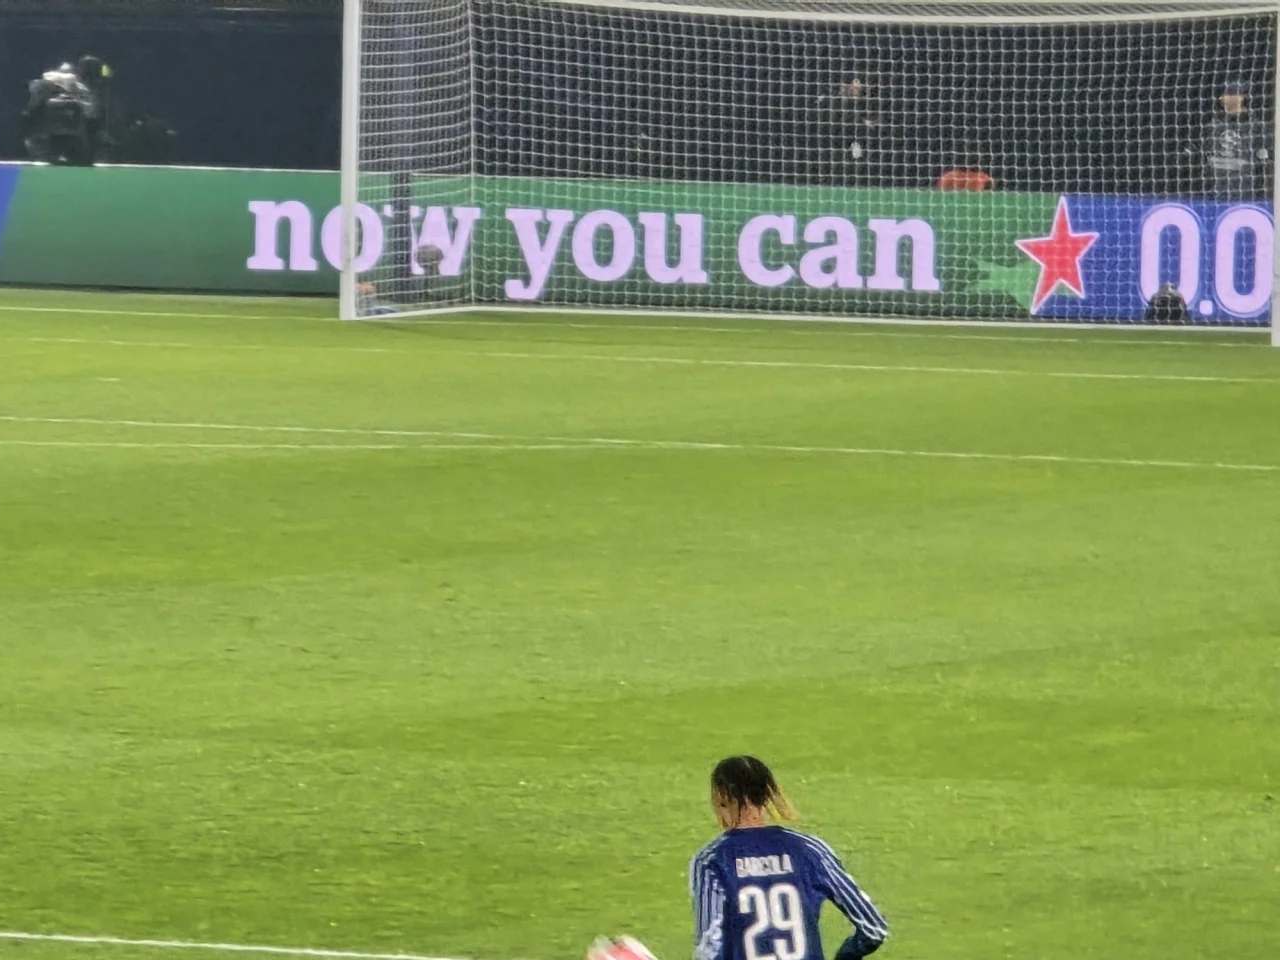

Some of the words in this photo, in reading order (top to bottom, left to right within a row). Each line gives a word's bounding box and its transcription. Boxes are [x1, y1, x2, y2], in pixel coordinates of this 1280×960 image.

[246, 199, 481, 278] now
[504, 207, 708, 301] you
[737, 213, 941, 292] can
